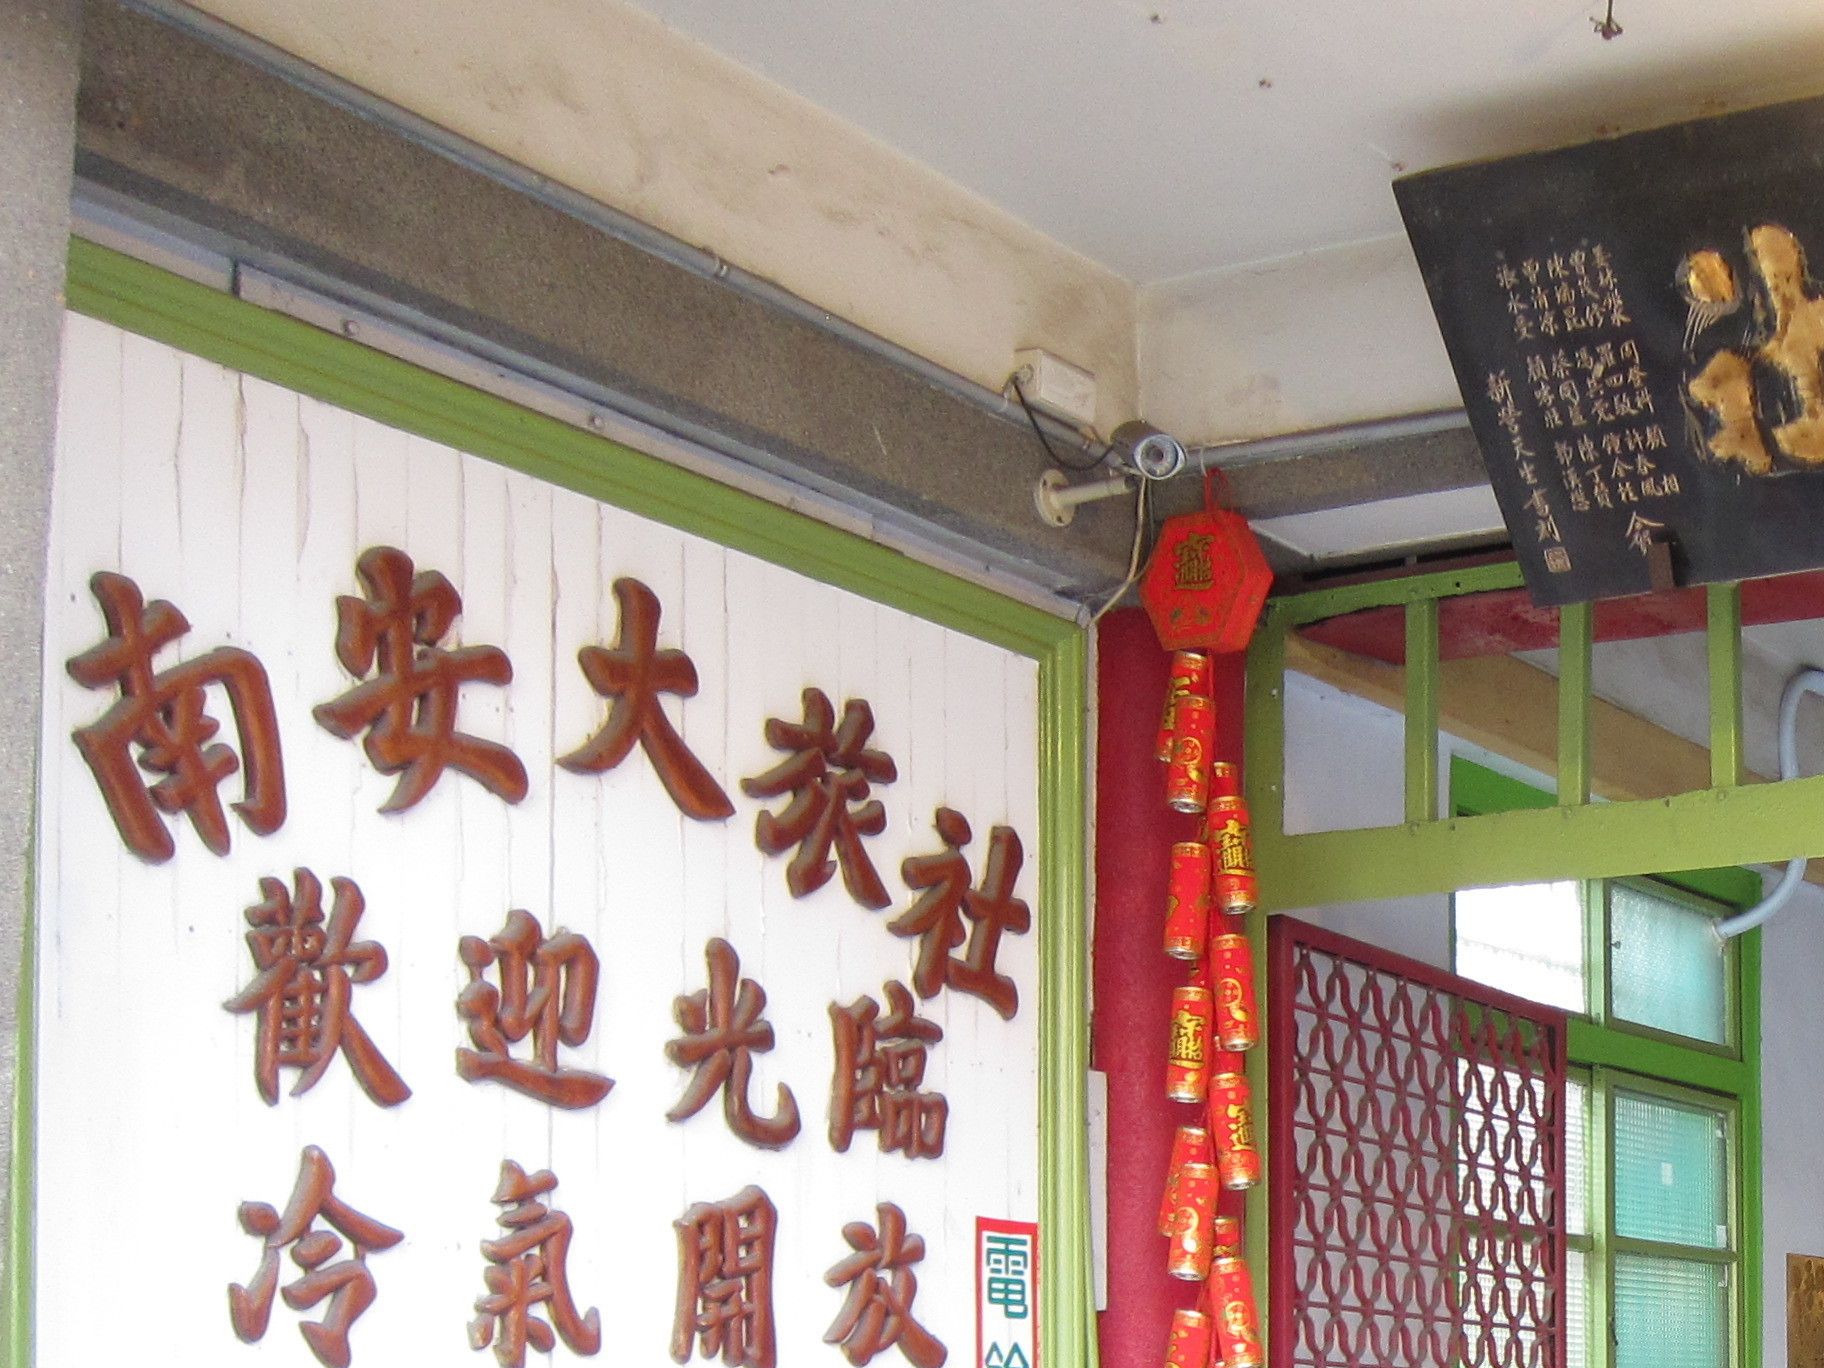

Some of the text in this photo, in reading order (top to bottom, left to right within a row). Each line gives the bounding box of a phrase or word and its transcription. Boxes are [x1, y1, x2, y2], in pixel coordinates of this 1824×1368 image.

[65, 546, 1031, 1020] 南安大旅社
[223, 867, 949, 1160] 歡迎光臨
